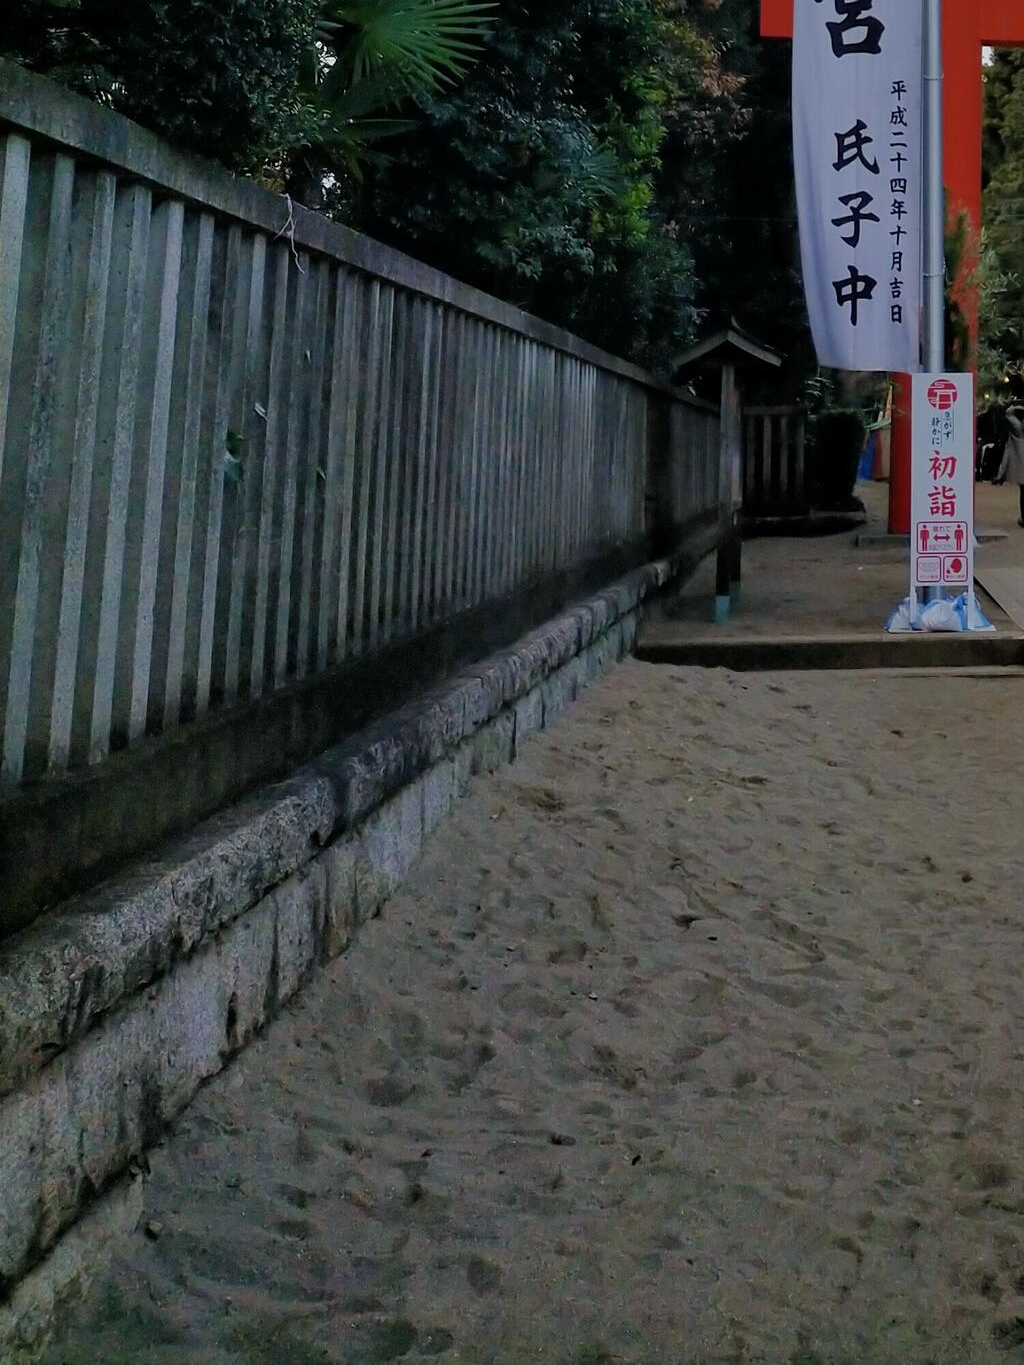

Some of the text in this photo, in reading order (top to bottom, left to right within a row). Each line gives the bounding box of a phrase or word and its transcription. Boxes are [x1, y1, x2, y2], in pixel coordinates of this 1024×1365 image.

[830, 118, 882, 327] 氏子中
[889, 79, 908, 324] 平成二十四年十月吉日
[927, 449, 957, 517] 初詣
